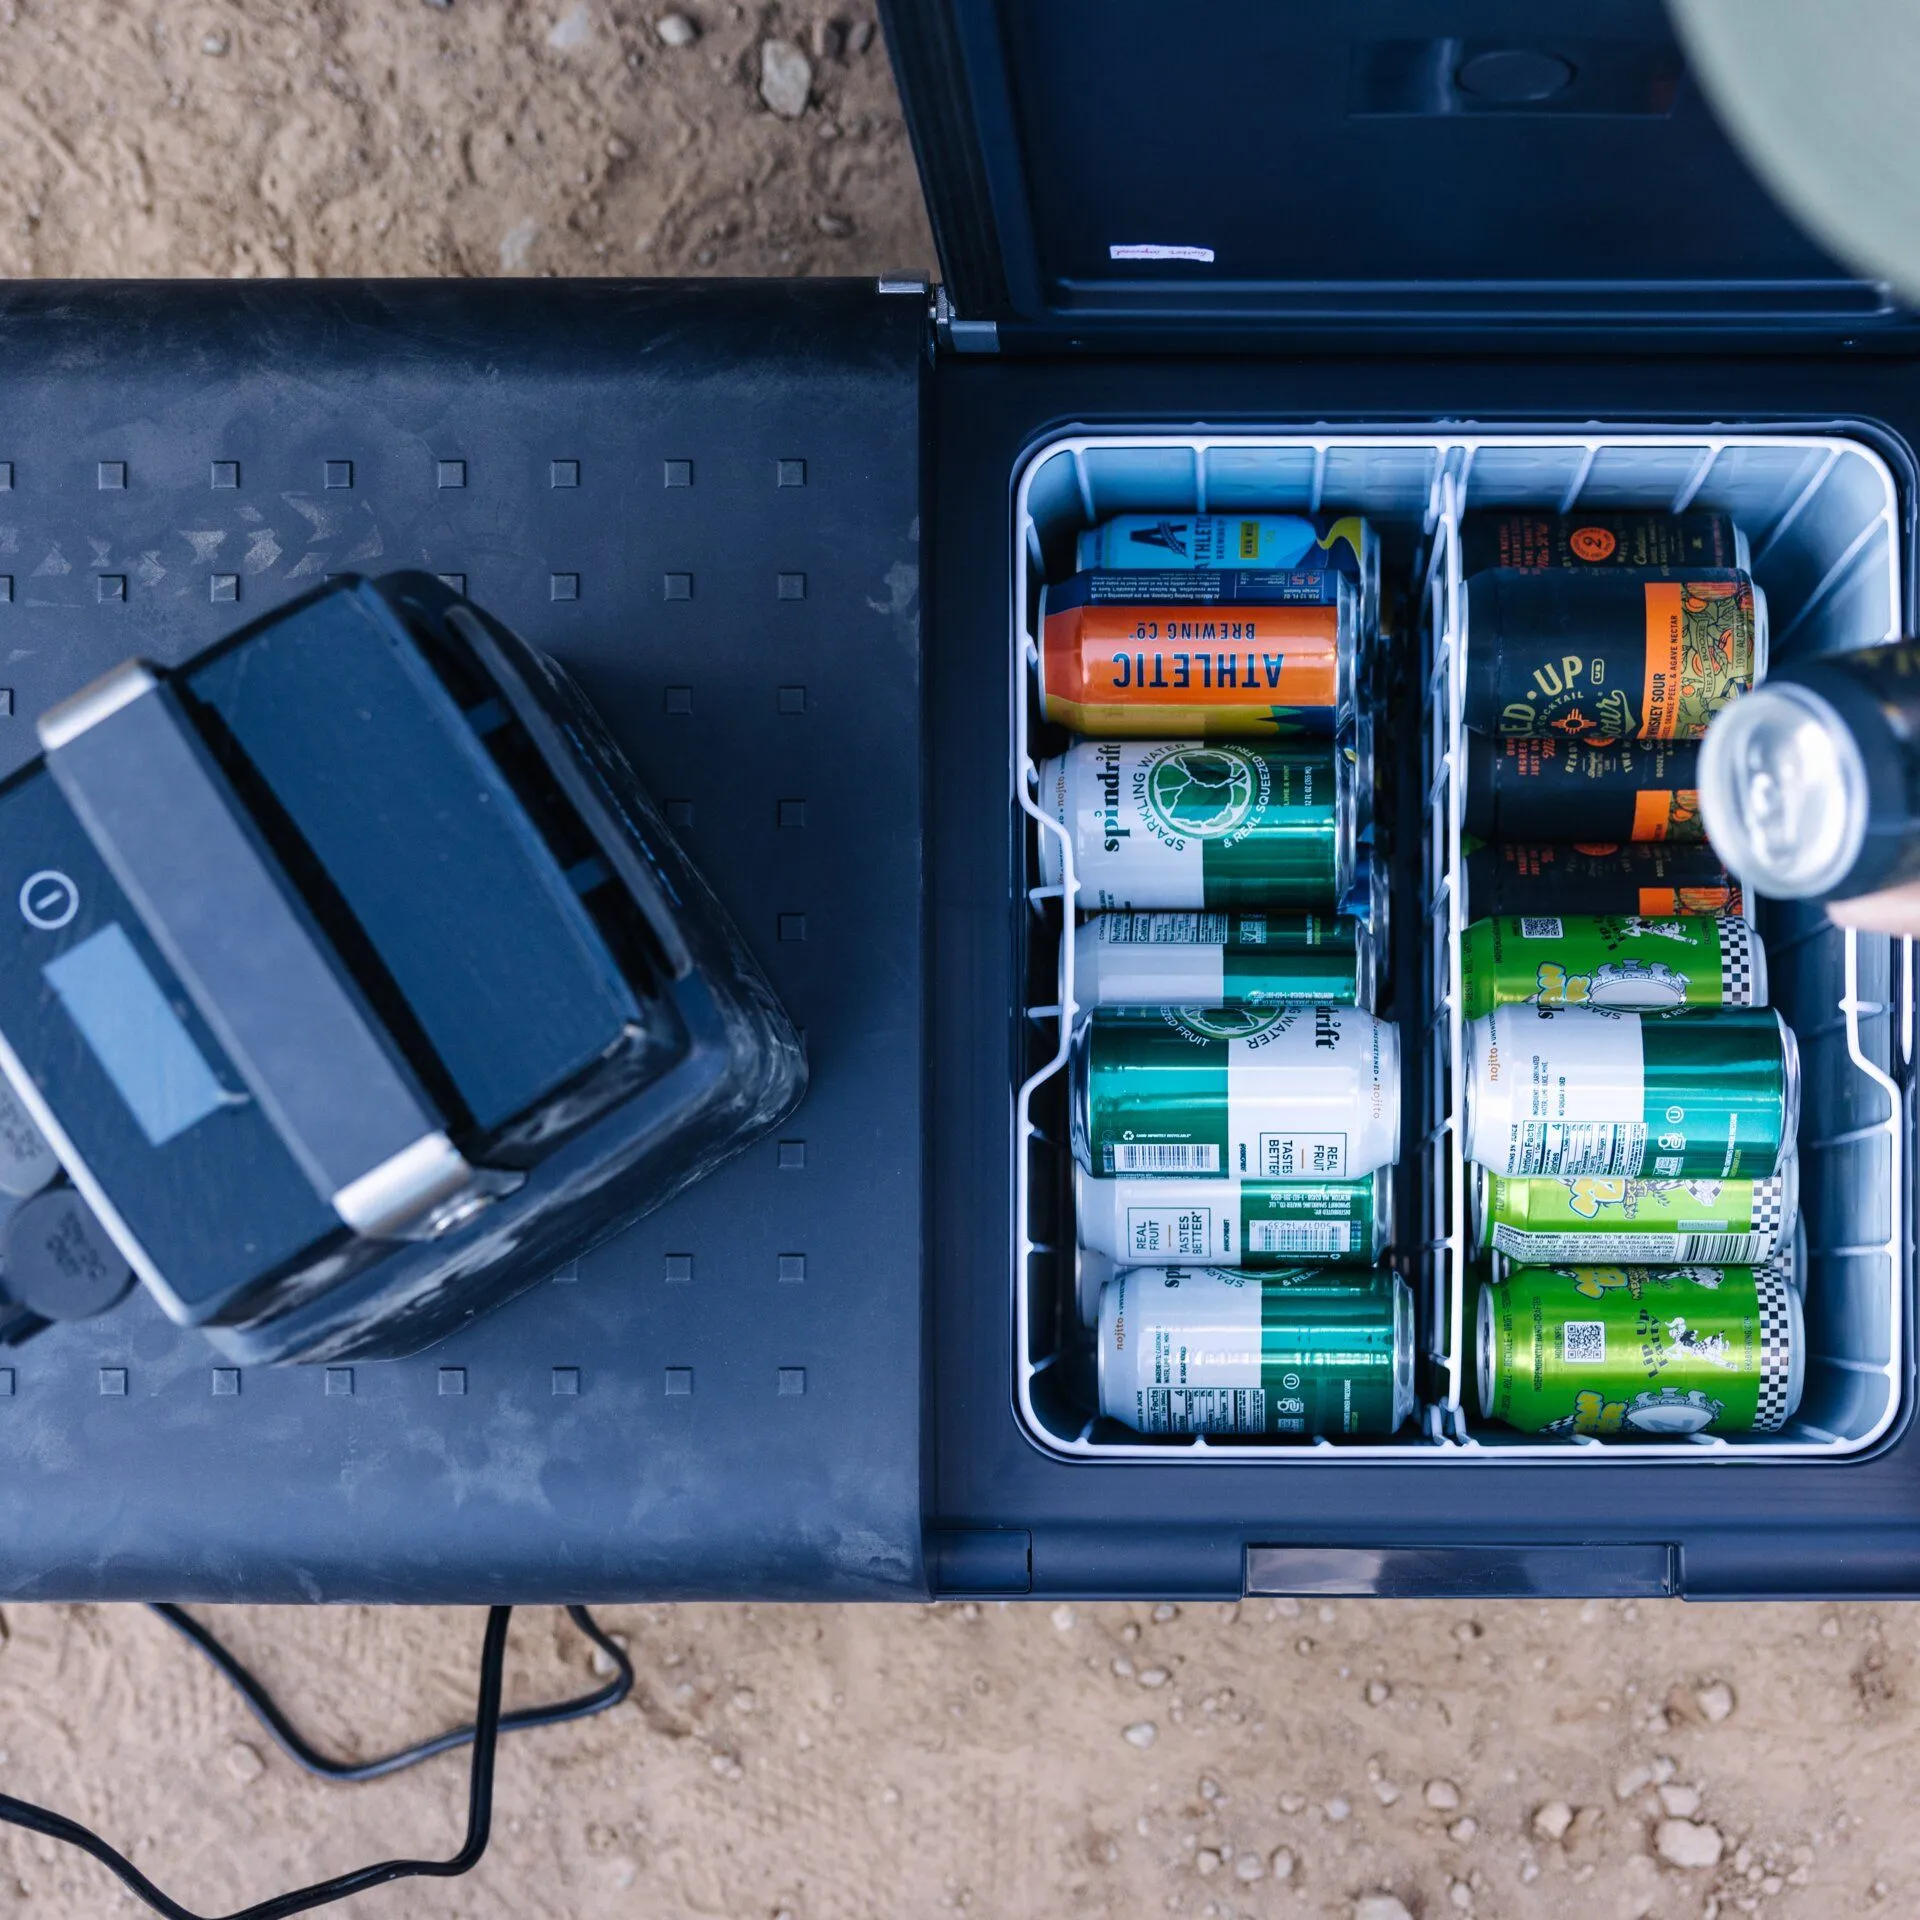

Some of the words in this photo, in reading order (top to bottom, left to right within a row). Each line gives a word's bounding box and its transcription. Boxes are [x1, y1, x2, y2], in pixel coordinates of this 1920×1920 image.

[1167, 621, 1256, 641] BREWING
[1670, 615, 1678, 644] NECTAR
[1697, 624, 1709, 662] BOOZE
[1112, 652, 1284, 689] ATHLETIC
[1670, 646, 1678, 671] AGAVE
[1532, 655, 1583, 696] UP
[1651, 673, 1666, 703] SOUR
[1704, 664, 1713, 693] REAL
[1137, 742, 1186, 768] WATER
[1530, 755, 1539, 776] JUST
[1056, 775, 1066, 807] nojito
[1094, 743, 1130, 852] spindrift
[1223, 837, 1233, 848] &
[1234, 815, 1262, 843] REAL
[1252, 755, 1271, 813] SQUEEZED
[1132, 772, 1186, 851] SPARKLING
[1174, 1026, 1211, 1047] FRUIT
[1245, 1015, 1298, 1050] WATER
[1314, 1006, 1342, 1050] drift
[1488, 1047, 1500, 1082] nojito
[1370, 1083, 1383, 1119] nojito
[1524, 1123, 1535, 1148] Facts
[1282, 1140, 1293, 1174] TASTES
[1313, 1144, 1325, 1172] FRUIT
[1326, 1146, 1338, 1171] REAL
[1548, 1152, 1560, 1174] Calories
[1136, 1221, 1147, 1250] REAL
[1148, 1220, 1159, 1251] FRUIT
[1179, 1216, 1190, 1254] TASTES
[1114, 1317, 1126, 1350] nojito
[1635, 1308, 1649, 1336] Up
[1503, 1337, 1513, 1368] RECYCLE
[1649, 1315, 1669, 1368] Fatty
[1640, 1344, 1659, 1379] Lip
[1150, 1390, 1160, 1411] Facts
[1174, 1389, 1185, 1397] 4
